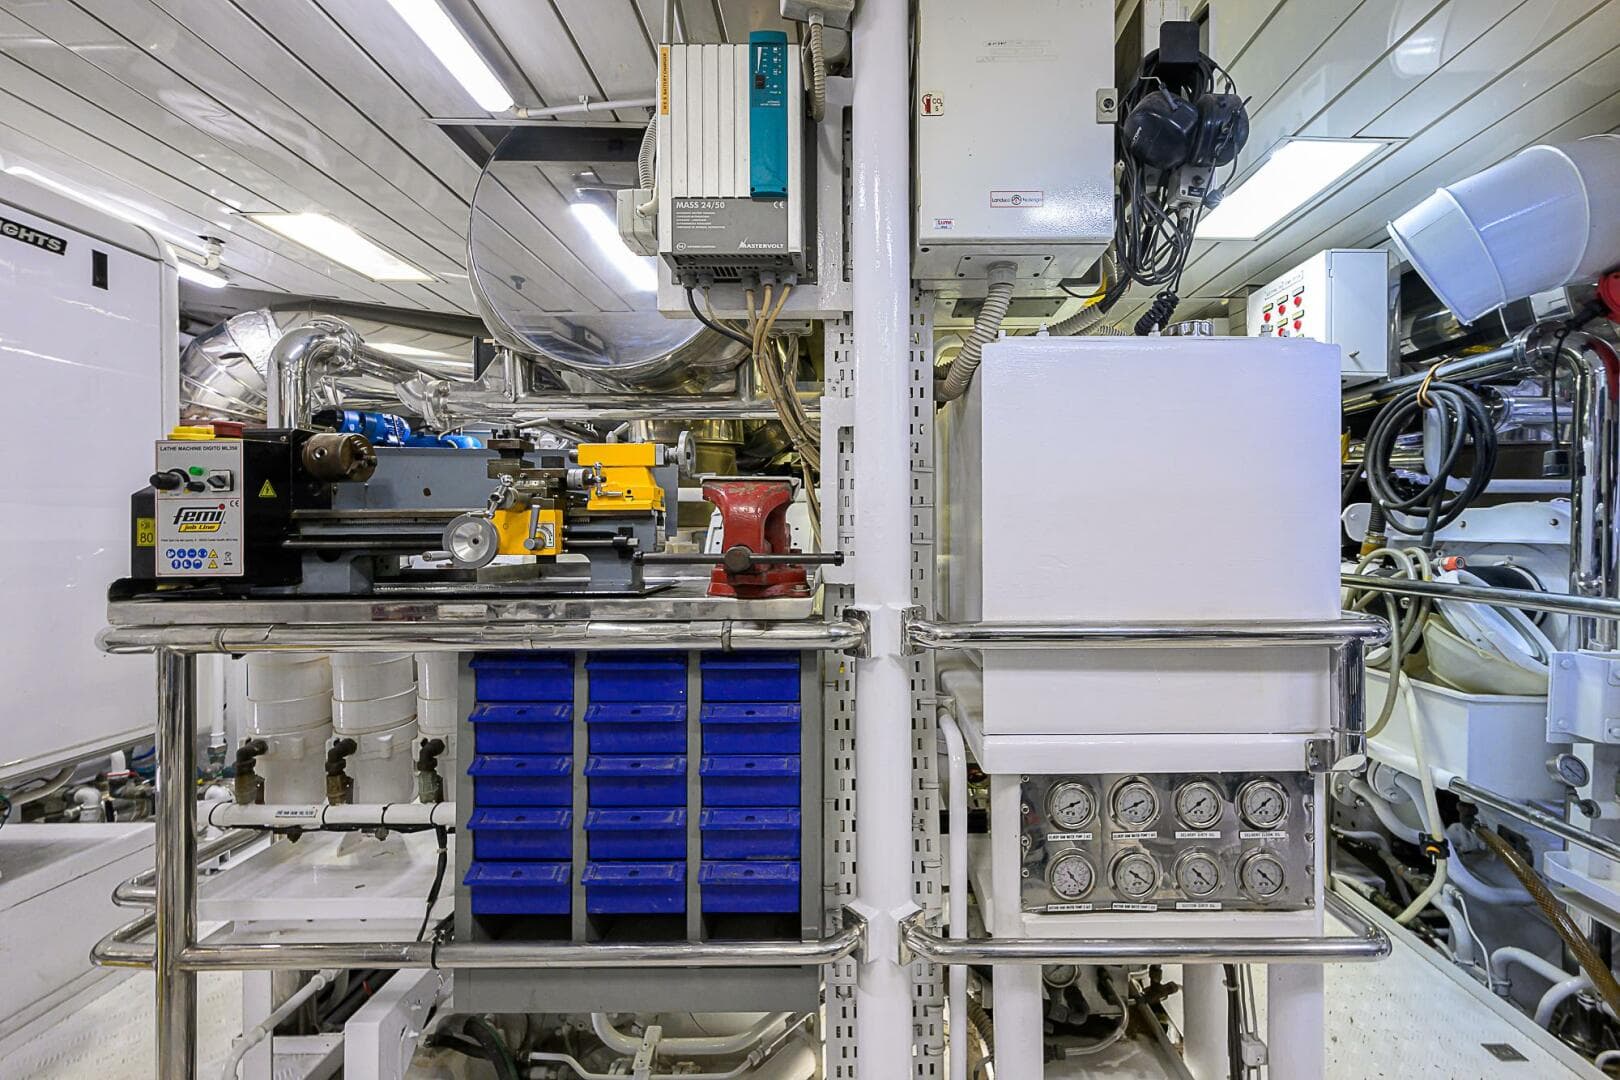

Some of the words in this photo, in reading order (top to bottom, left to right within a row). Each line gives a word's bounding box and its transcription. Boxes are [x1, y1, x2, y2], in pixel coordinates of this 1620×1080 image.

[676, 201, 699, 209] MASS
[701, 201, 725, 210] 24/50
[738, 240, 784, 250] MASTERVOLT
[173, 503, 226, 525] femi
[140, 532, 154, 543] 80
